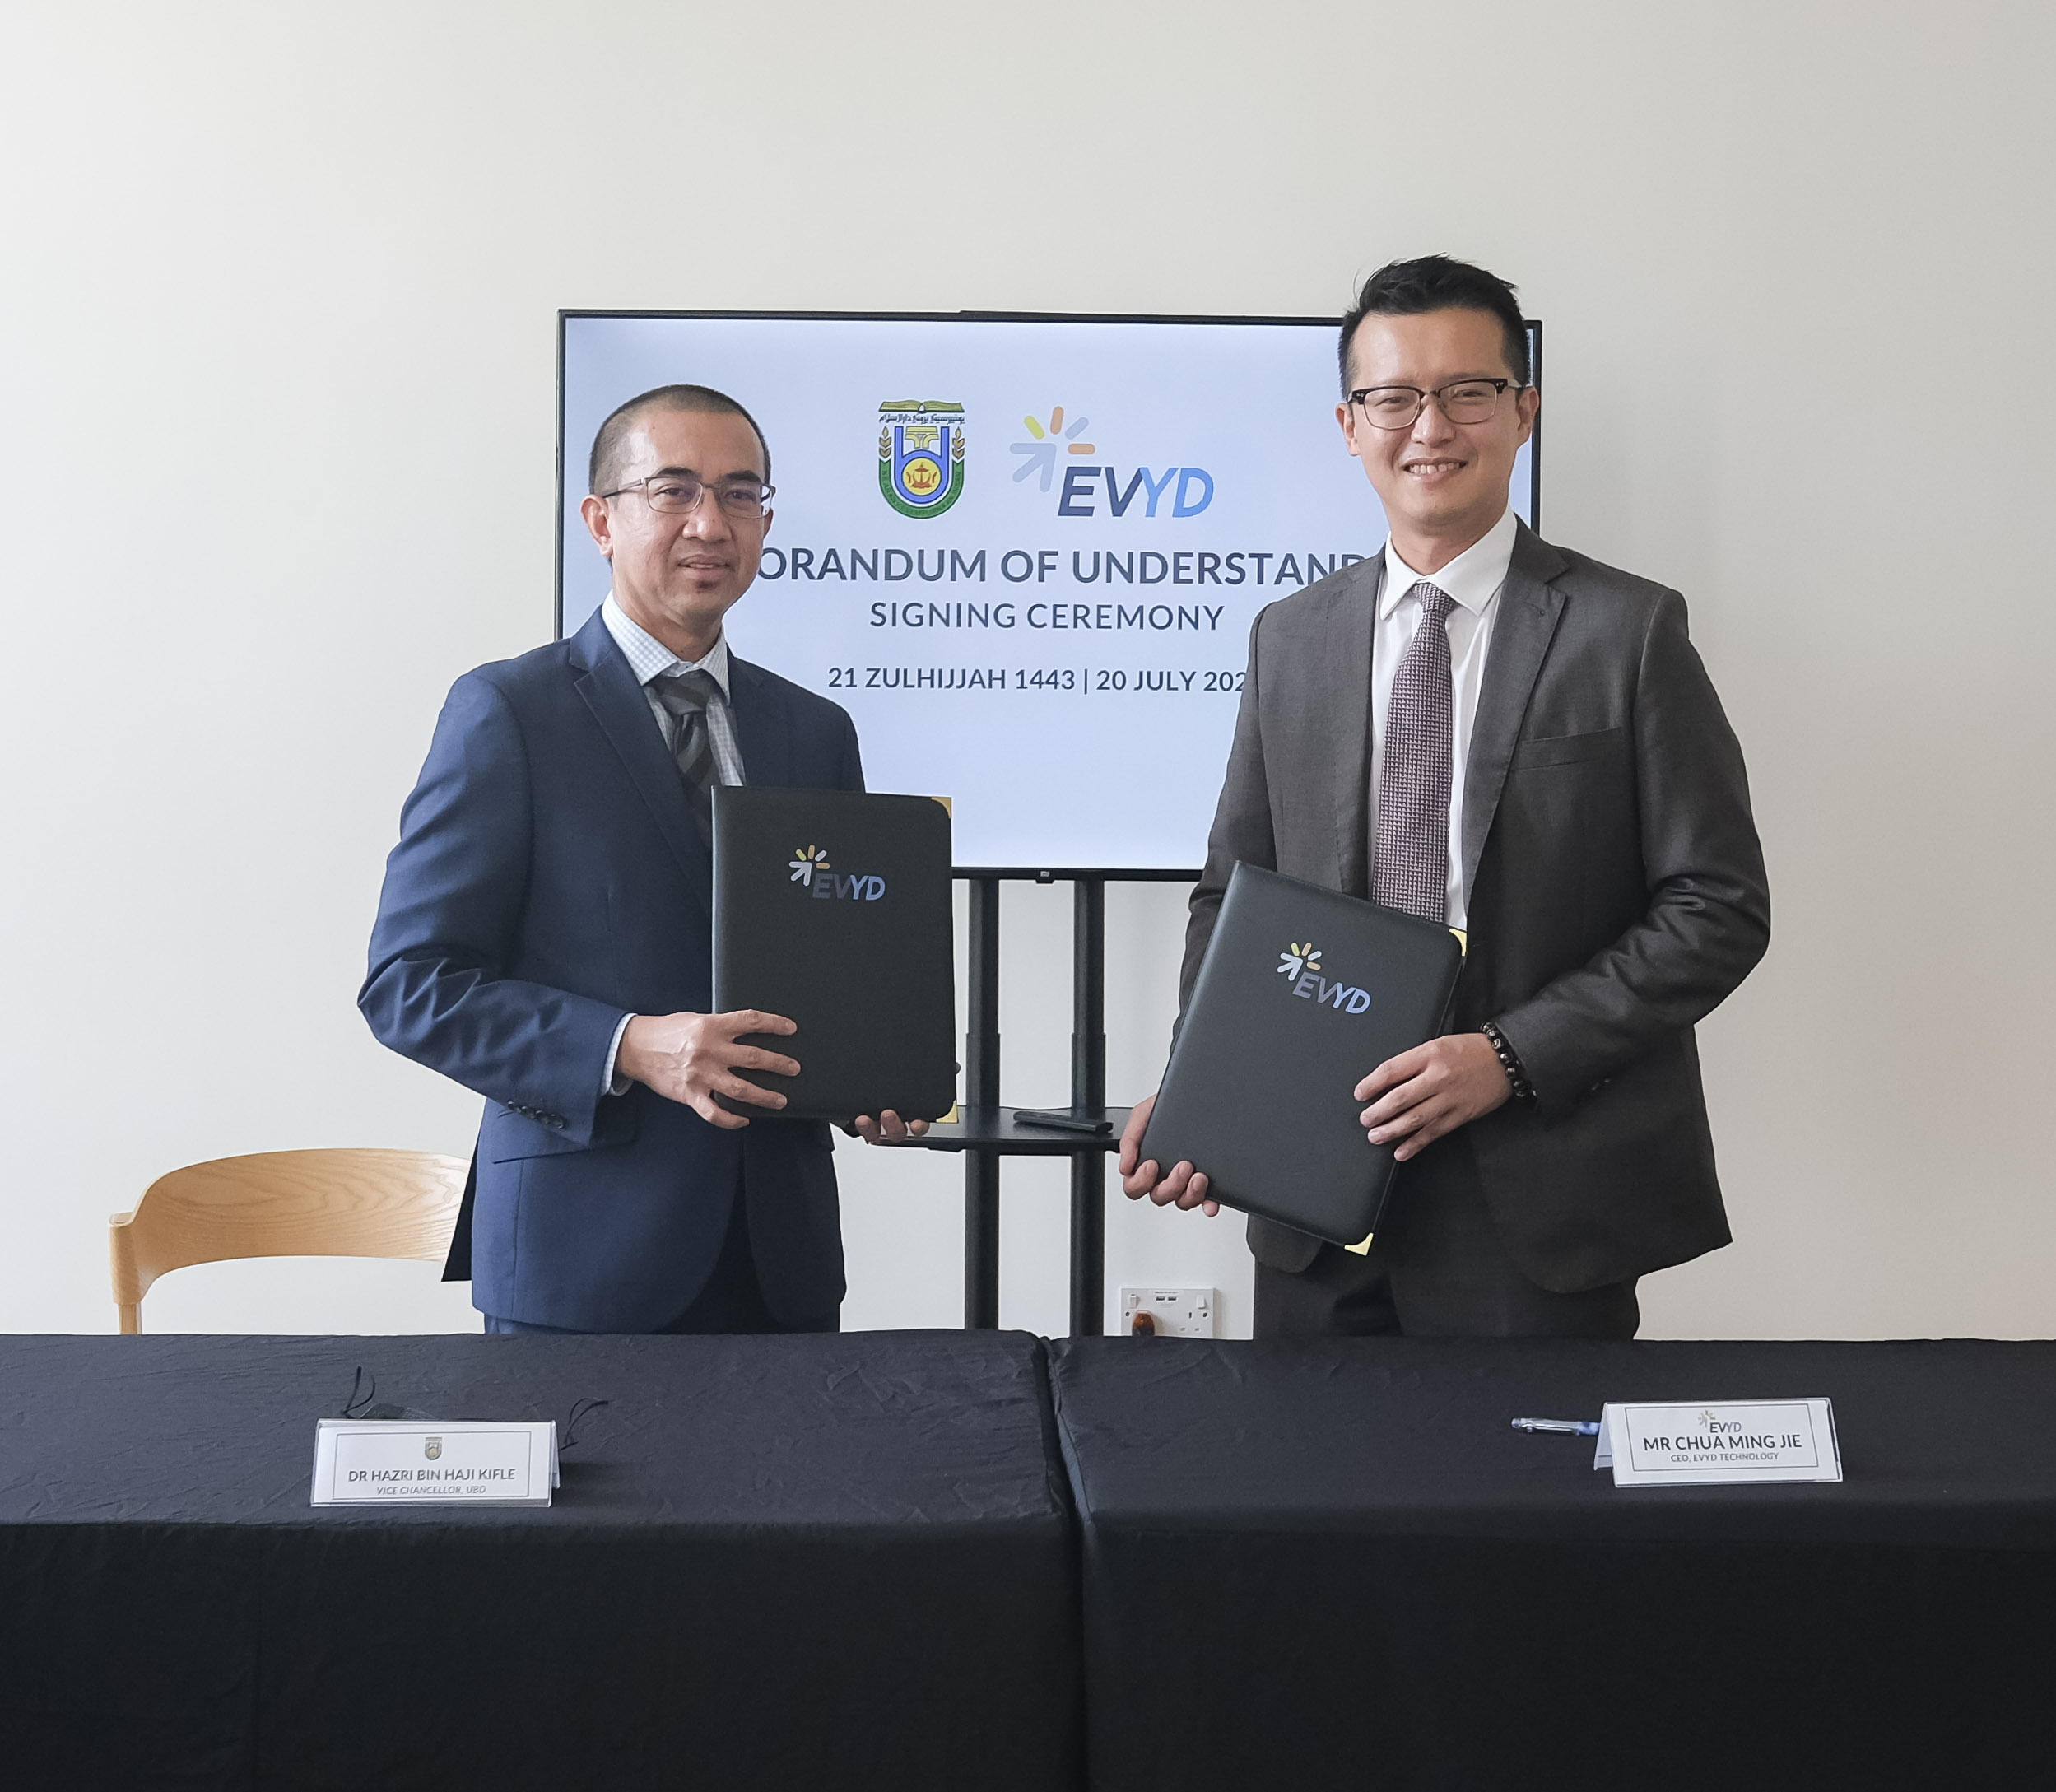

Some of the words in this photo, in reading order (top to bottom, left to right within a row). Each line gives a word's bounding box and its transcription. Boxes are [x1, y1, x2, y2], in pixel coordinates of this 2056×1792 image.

[1058, 466, 1214, 518] EVYD
[1000, 550, 1059, 583] OF
[869, 602, 1016, 628] SIGNING
[1026, 603, 1225, 631] CEREMONY
[828, 668, 858, 688] 21
[865, 668, 1007, 690] ZULHIJJAH
[1015, 669, 1075, 690] 1443
[1096, 670, 1127, 691] 20
[1133, 670, 1197, 691] JULY
[812, 873, 886, 901] EVYD
[1292, 971, 1371, 1014] EVYD
[1709, 1422, 1742, 1434] EVYD
[1643, 1436, 1672, 1451] MR
[1675, 1436, 1726, 1450] CHUA
[1729, 1435, 1775, 1450] MING
[1780, 1434, 1802, 1449] JIE
[1693, 1453, 1718, 1462] EVYD
[1719, 1452, 1779, 1461] TECHNOLOGY
[348, 1470, 368, 1482] DR
[371, 1469, 413, 1482] HAZRI
[417, 1469, 440, 1481] BIN
[444, 1469, 475, 1481] HAJI
[478, 1468, 516, 1480] KIFLE
[376, 1486, 398, 1495] VICE
[466, 1485, 486, 1494] UBD
